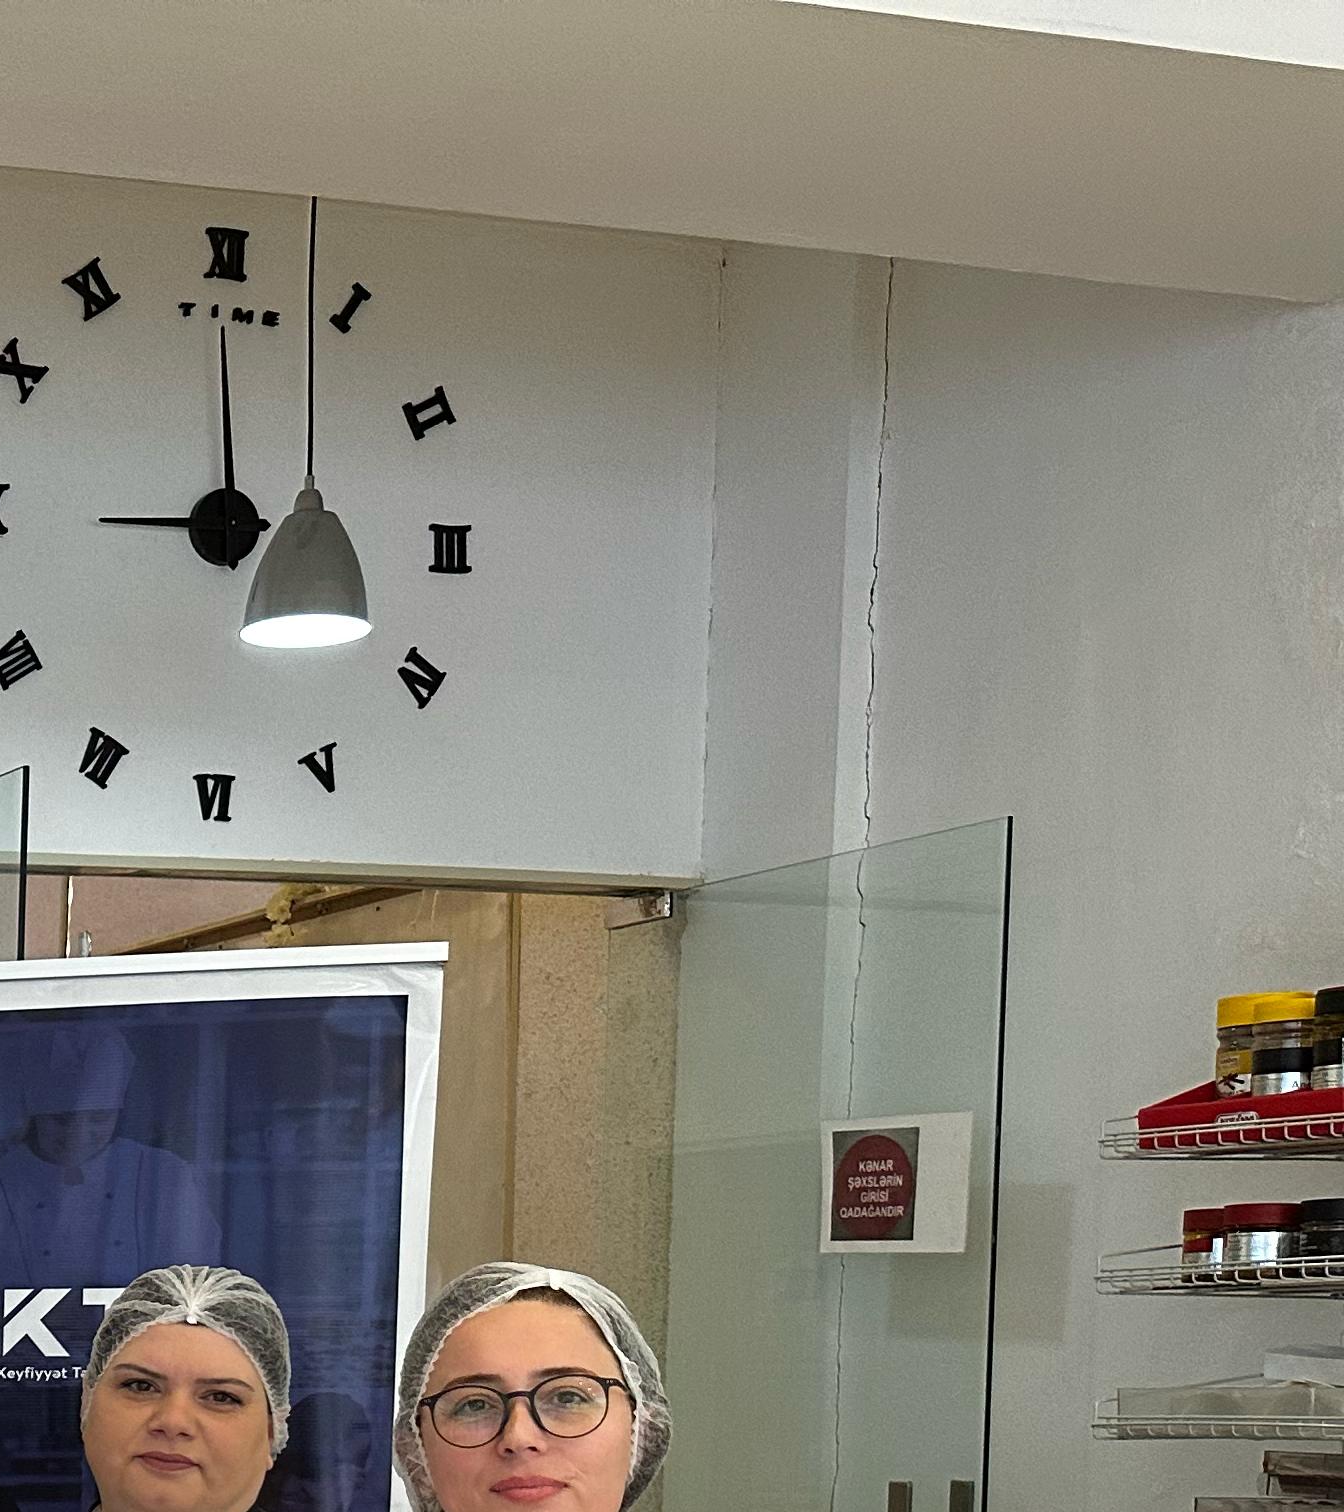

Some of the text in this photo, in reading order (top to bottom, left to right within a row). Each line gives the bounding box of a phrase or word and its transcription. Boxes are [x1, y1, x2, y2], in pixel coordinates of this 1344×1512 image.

[204, 227, 250, 282] XII
[62, 257, 122, 322] XI
[178, 302, 281, 328] TIME
[401, 386, 457, 441] II
[428, 524, 473, 574] III
[397, 646, 447, 710] IV
[79, 726, 130, 790] VII
[297, 742, 338, 793] V
[193, 773, 236, 822] VI
[859, 1159, 894, 1172] KƏNAR
[840, 1205, 904, 1218] QADAĞANDIR
